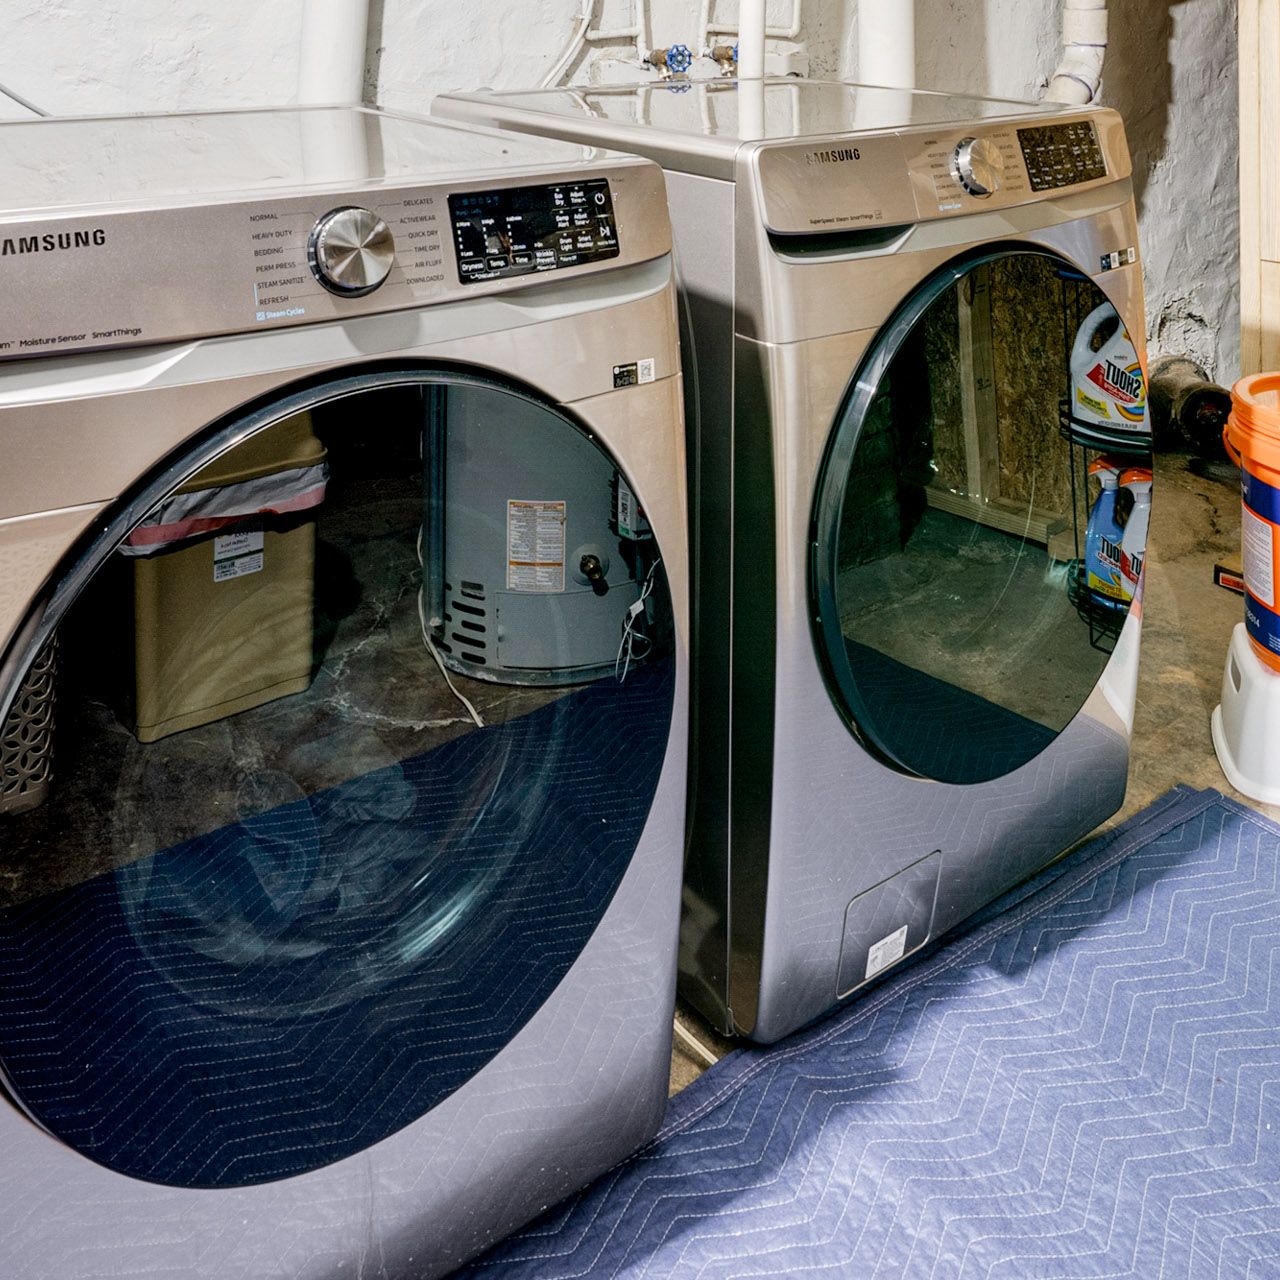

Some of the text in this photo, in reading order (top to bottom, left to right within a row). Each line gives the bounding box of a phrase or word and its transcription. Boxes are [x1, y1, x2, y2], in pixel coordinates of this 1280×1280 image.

[403, 197, 434, 207] DELICATES
[249, 212, 279, 222] NORMAL
[399, 214, 436, 224] ACTIVEWEAR
[251, 229, 293, 241] HEAVY DUTY
[408, 229, 439, 239] QUICK DRY
[253, 246, 284, 257] BEDDING
[414, 244, 441, 253] TIME DRY
[255, 261, 296, 273] PERM PRESS
[414, 259, 442, 269] AIR FLUFF
[461, 261, 484, 271] Dryness
[257, 279, 278, 290] STEAM
[406, 274, 445, 285] DOWNLOADED
[259, 295, 290, 306] REFRESH
[266, 307, 305, 319] Steam Cycles
[19, 336, 57, 348] Moisture
[57, 333, 87, 344] Sensor
[92, 327, 142, 340] SmartThings
